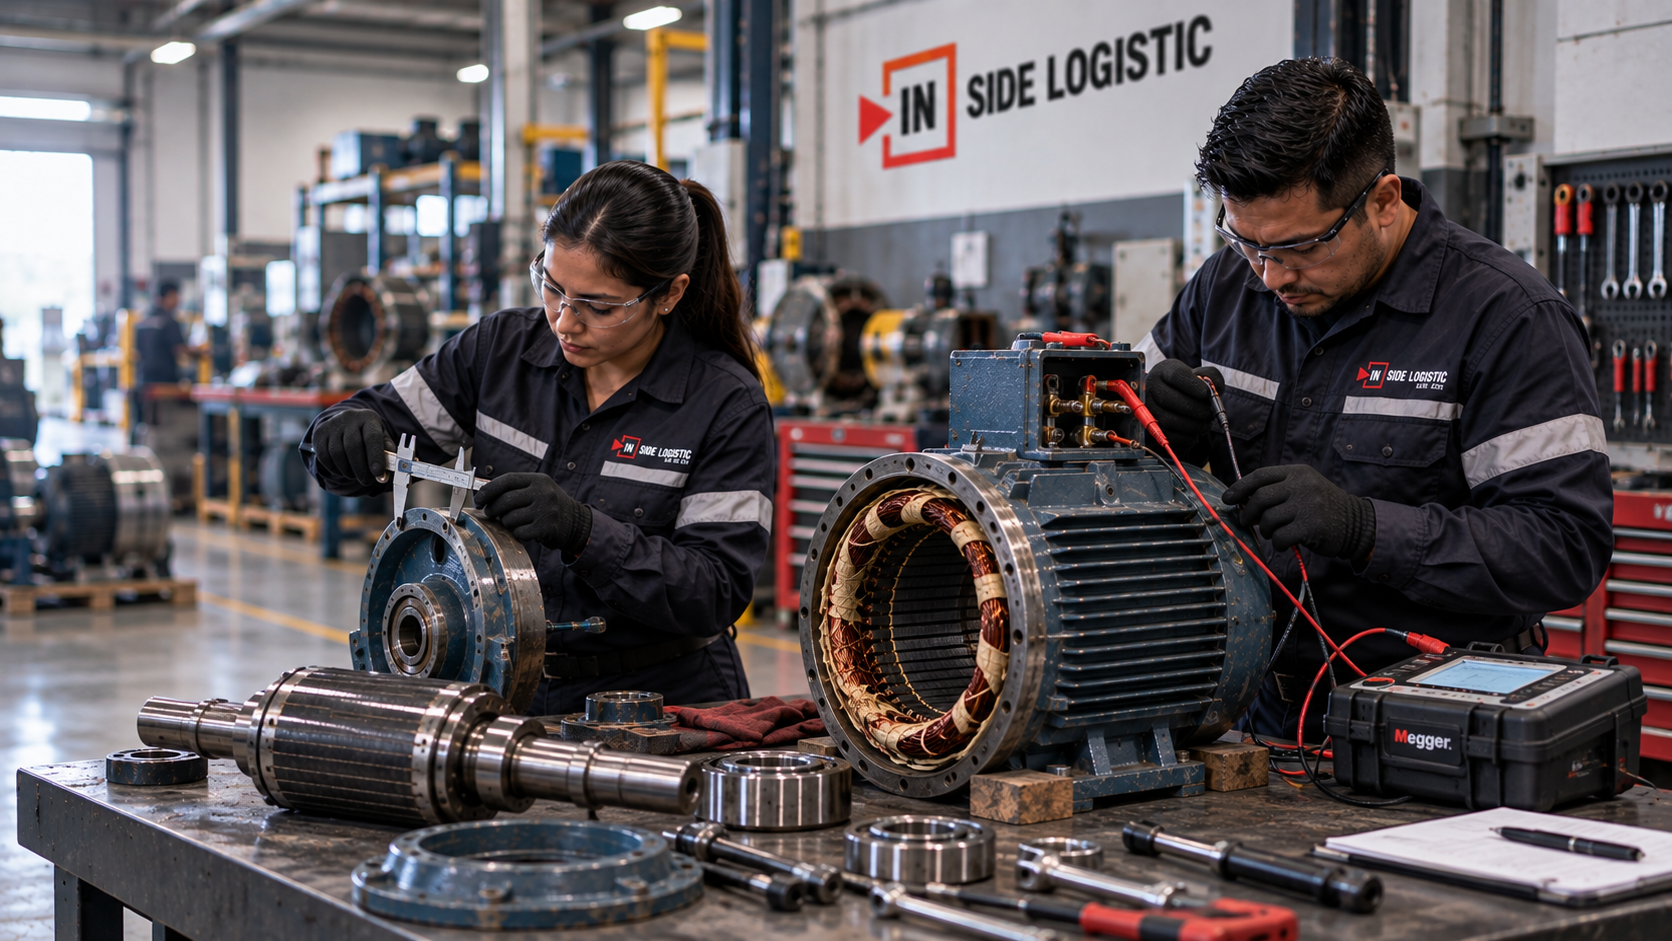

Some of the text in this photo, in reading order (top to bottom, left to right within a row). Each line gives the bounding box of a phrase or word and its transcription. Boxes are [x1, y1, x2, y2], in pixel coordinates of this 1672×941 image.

[900, 14, 1213, 136] IN SIDE LOGISTIC
[1369, 369, 1448, 383] IN SIDE LOGISTIC
[623, 442, 635, 453] IN
